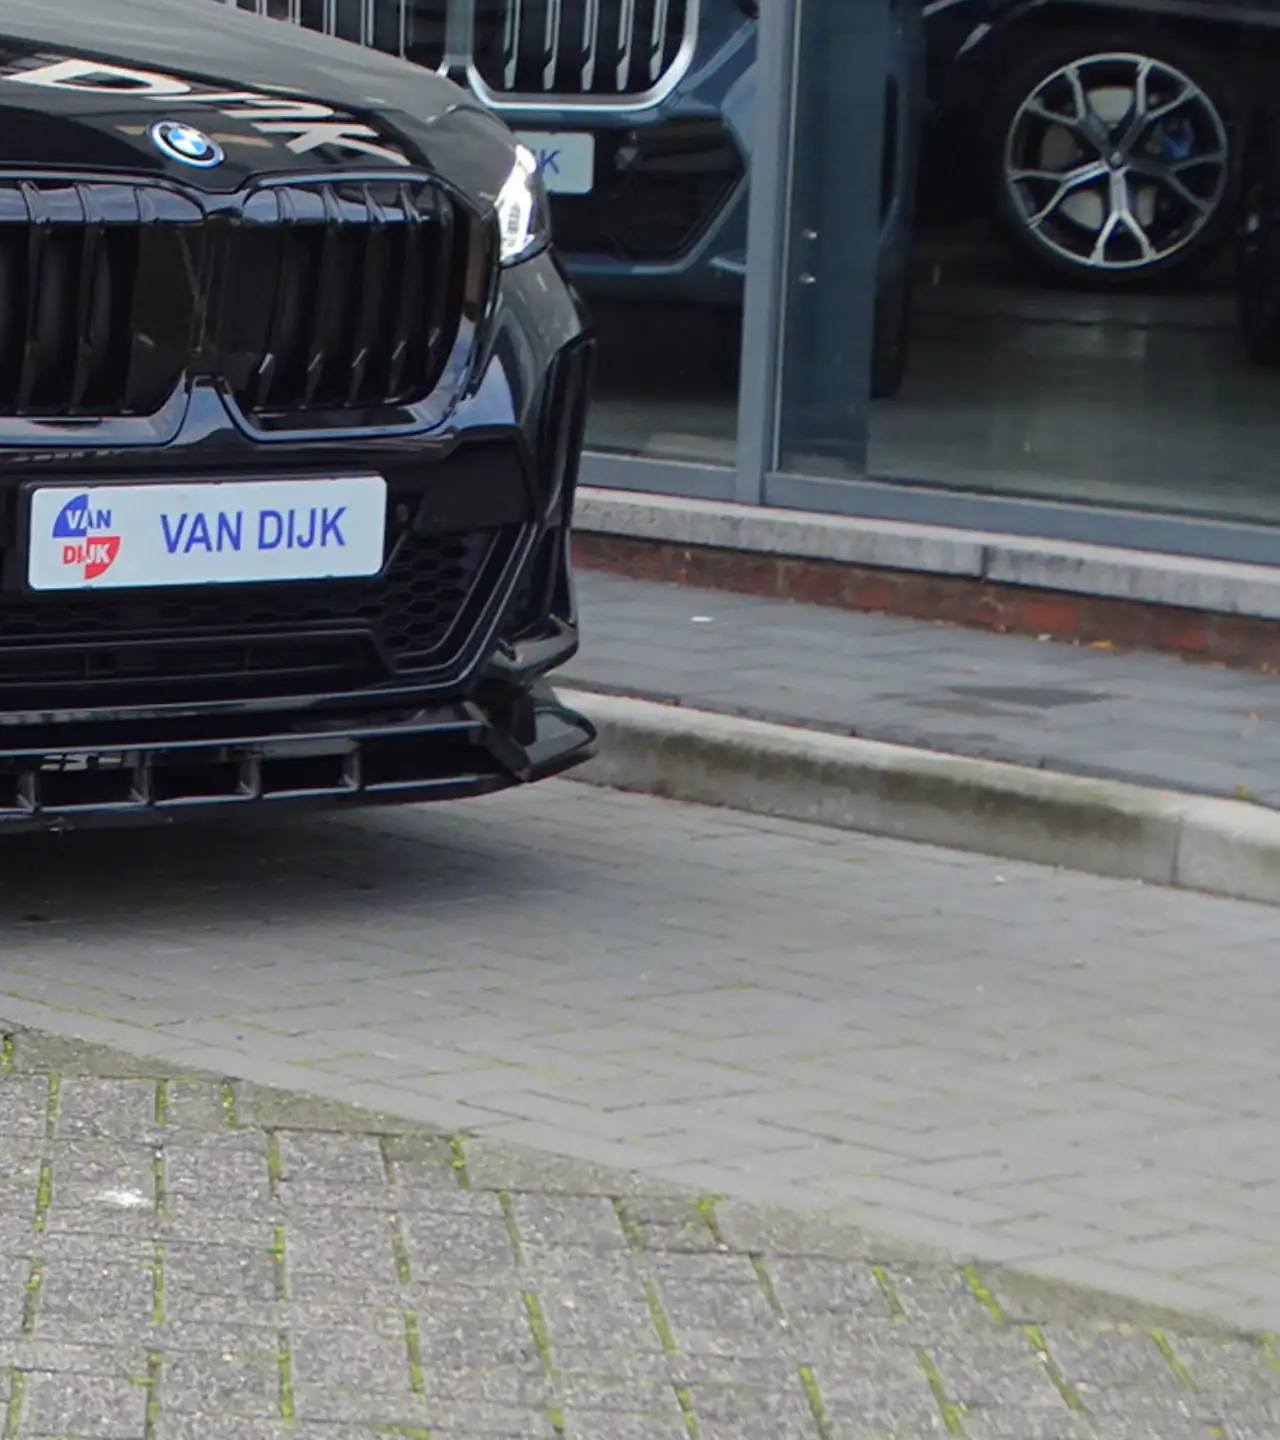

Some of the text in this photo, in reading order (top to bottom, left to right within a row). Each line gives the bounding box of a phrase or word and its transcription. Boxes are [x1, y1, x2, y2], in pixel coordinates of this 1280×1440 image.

[65, 508, 112, 530] VAN
[160, 506, 347, 554] VAN DIJK
[62, 543, 112, 565] DIJK
